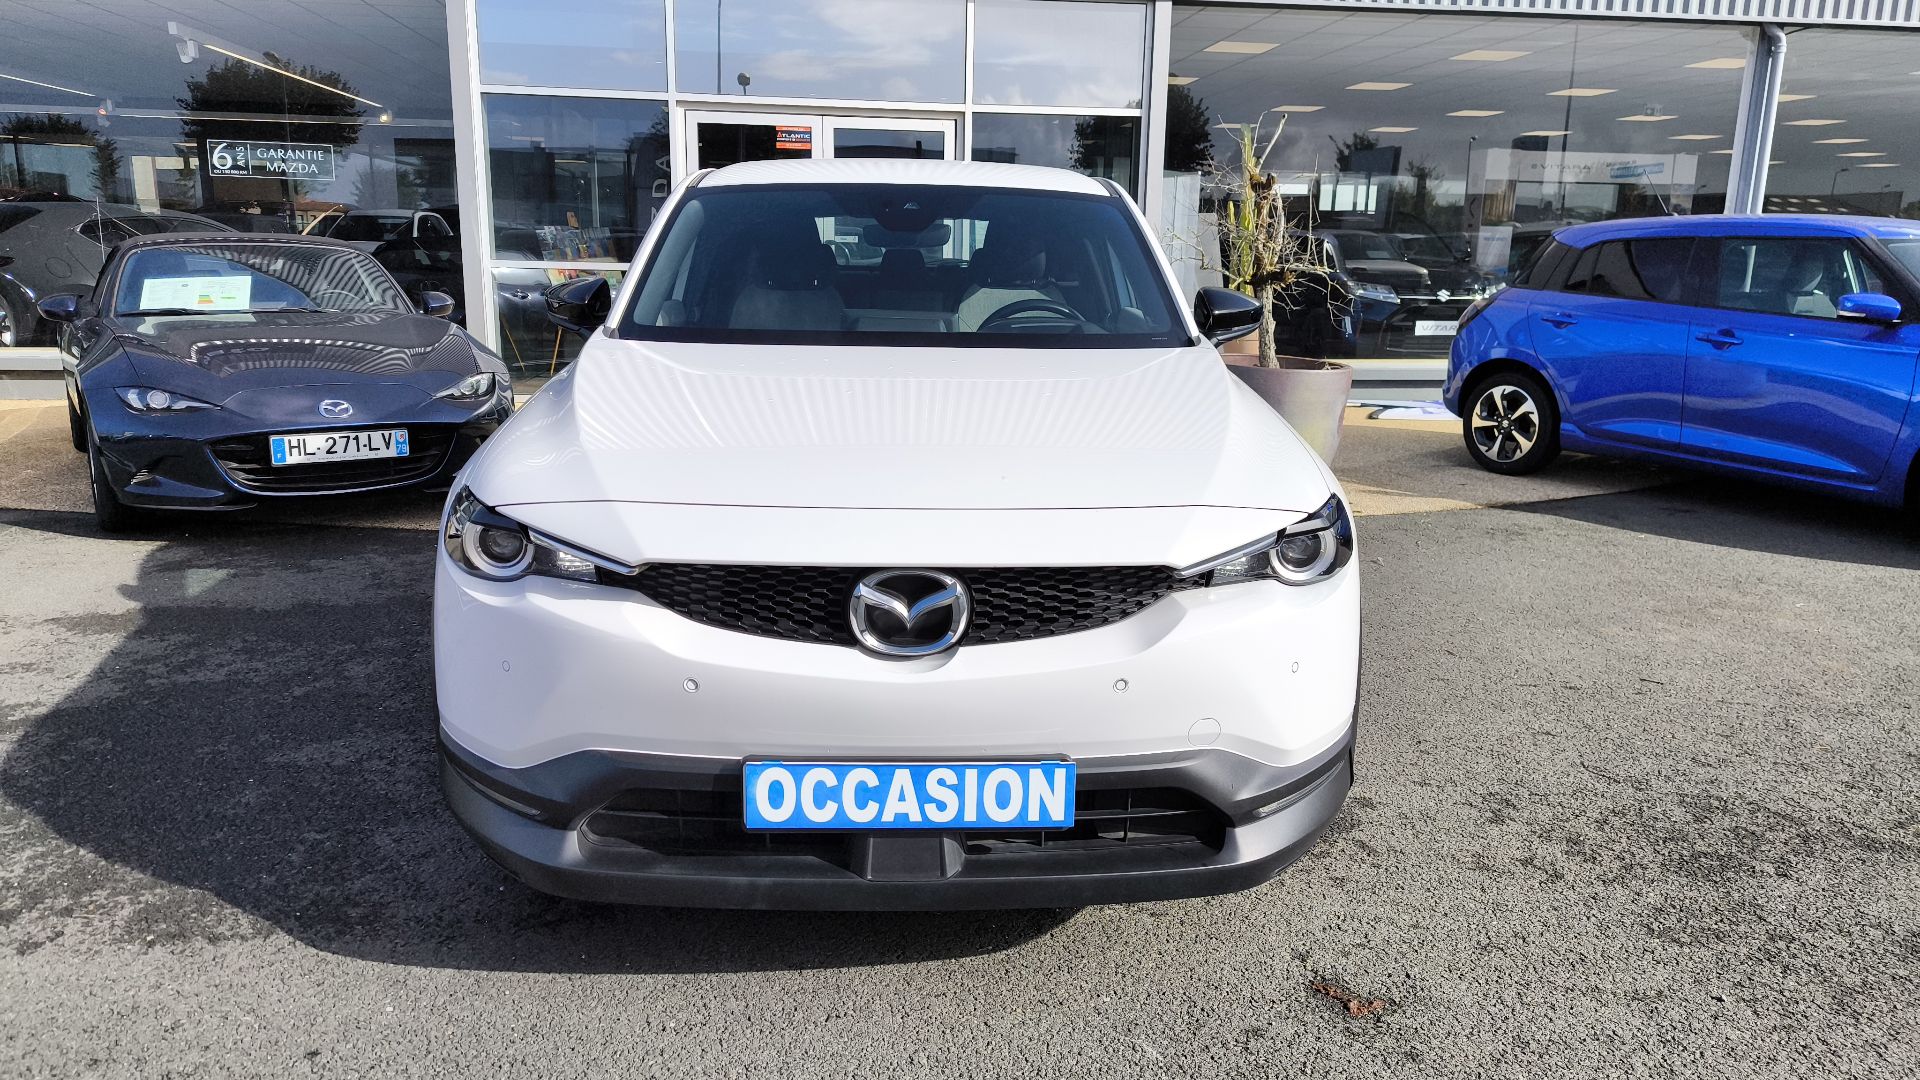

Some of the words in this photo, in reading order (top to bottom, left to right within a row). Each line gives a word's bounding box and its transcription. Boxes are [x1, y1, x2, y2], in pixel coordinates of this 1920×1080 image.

[777, 131, 811, 139] ATLANTIC
[212, 142, 233, 170] 6
[236, 146, 246, 168] ANS
[257, 148, 325, 161] GARANTIE
[266, 161, 319, 174] MAZDA
[288, 432, 392, 457] HL-271-LV
[396, 444, 407, 453] 79
[755, 766, 1067, 823] OCCASION
